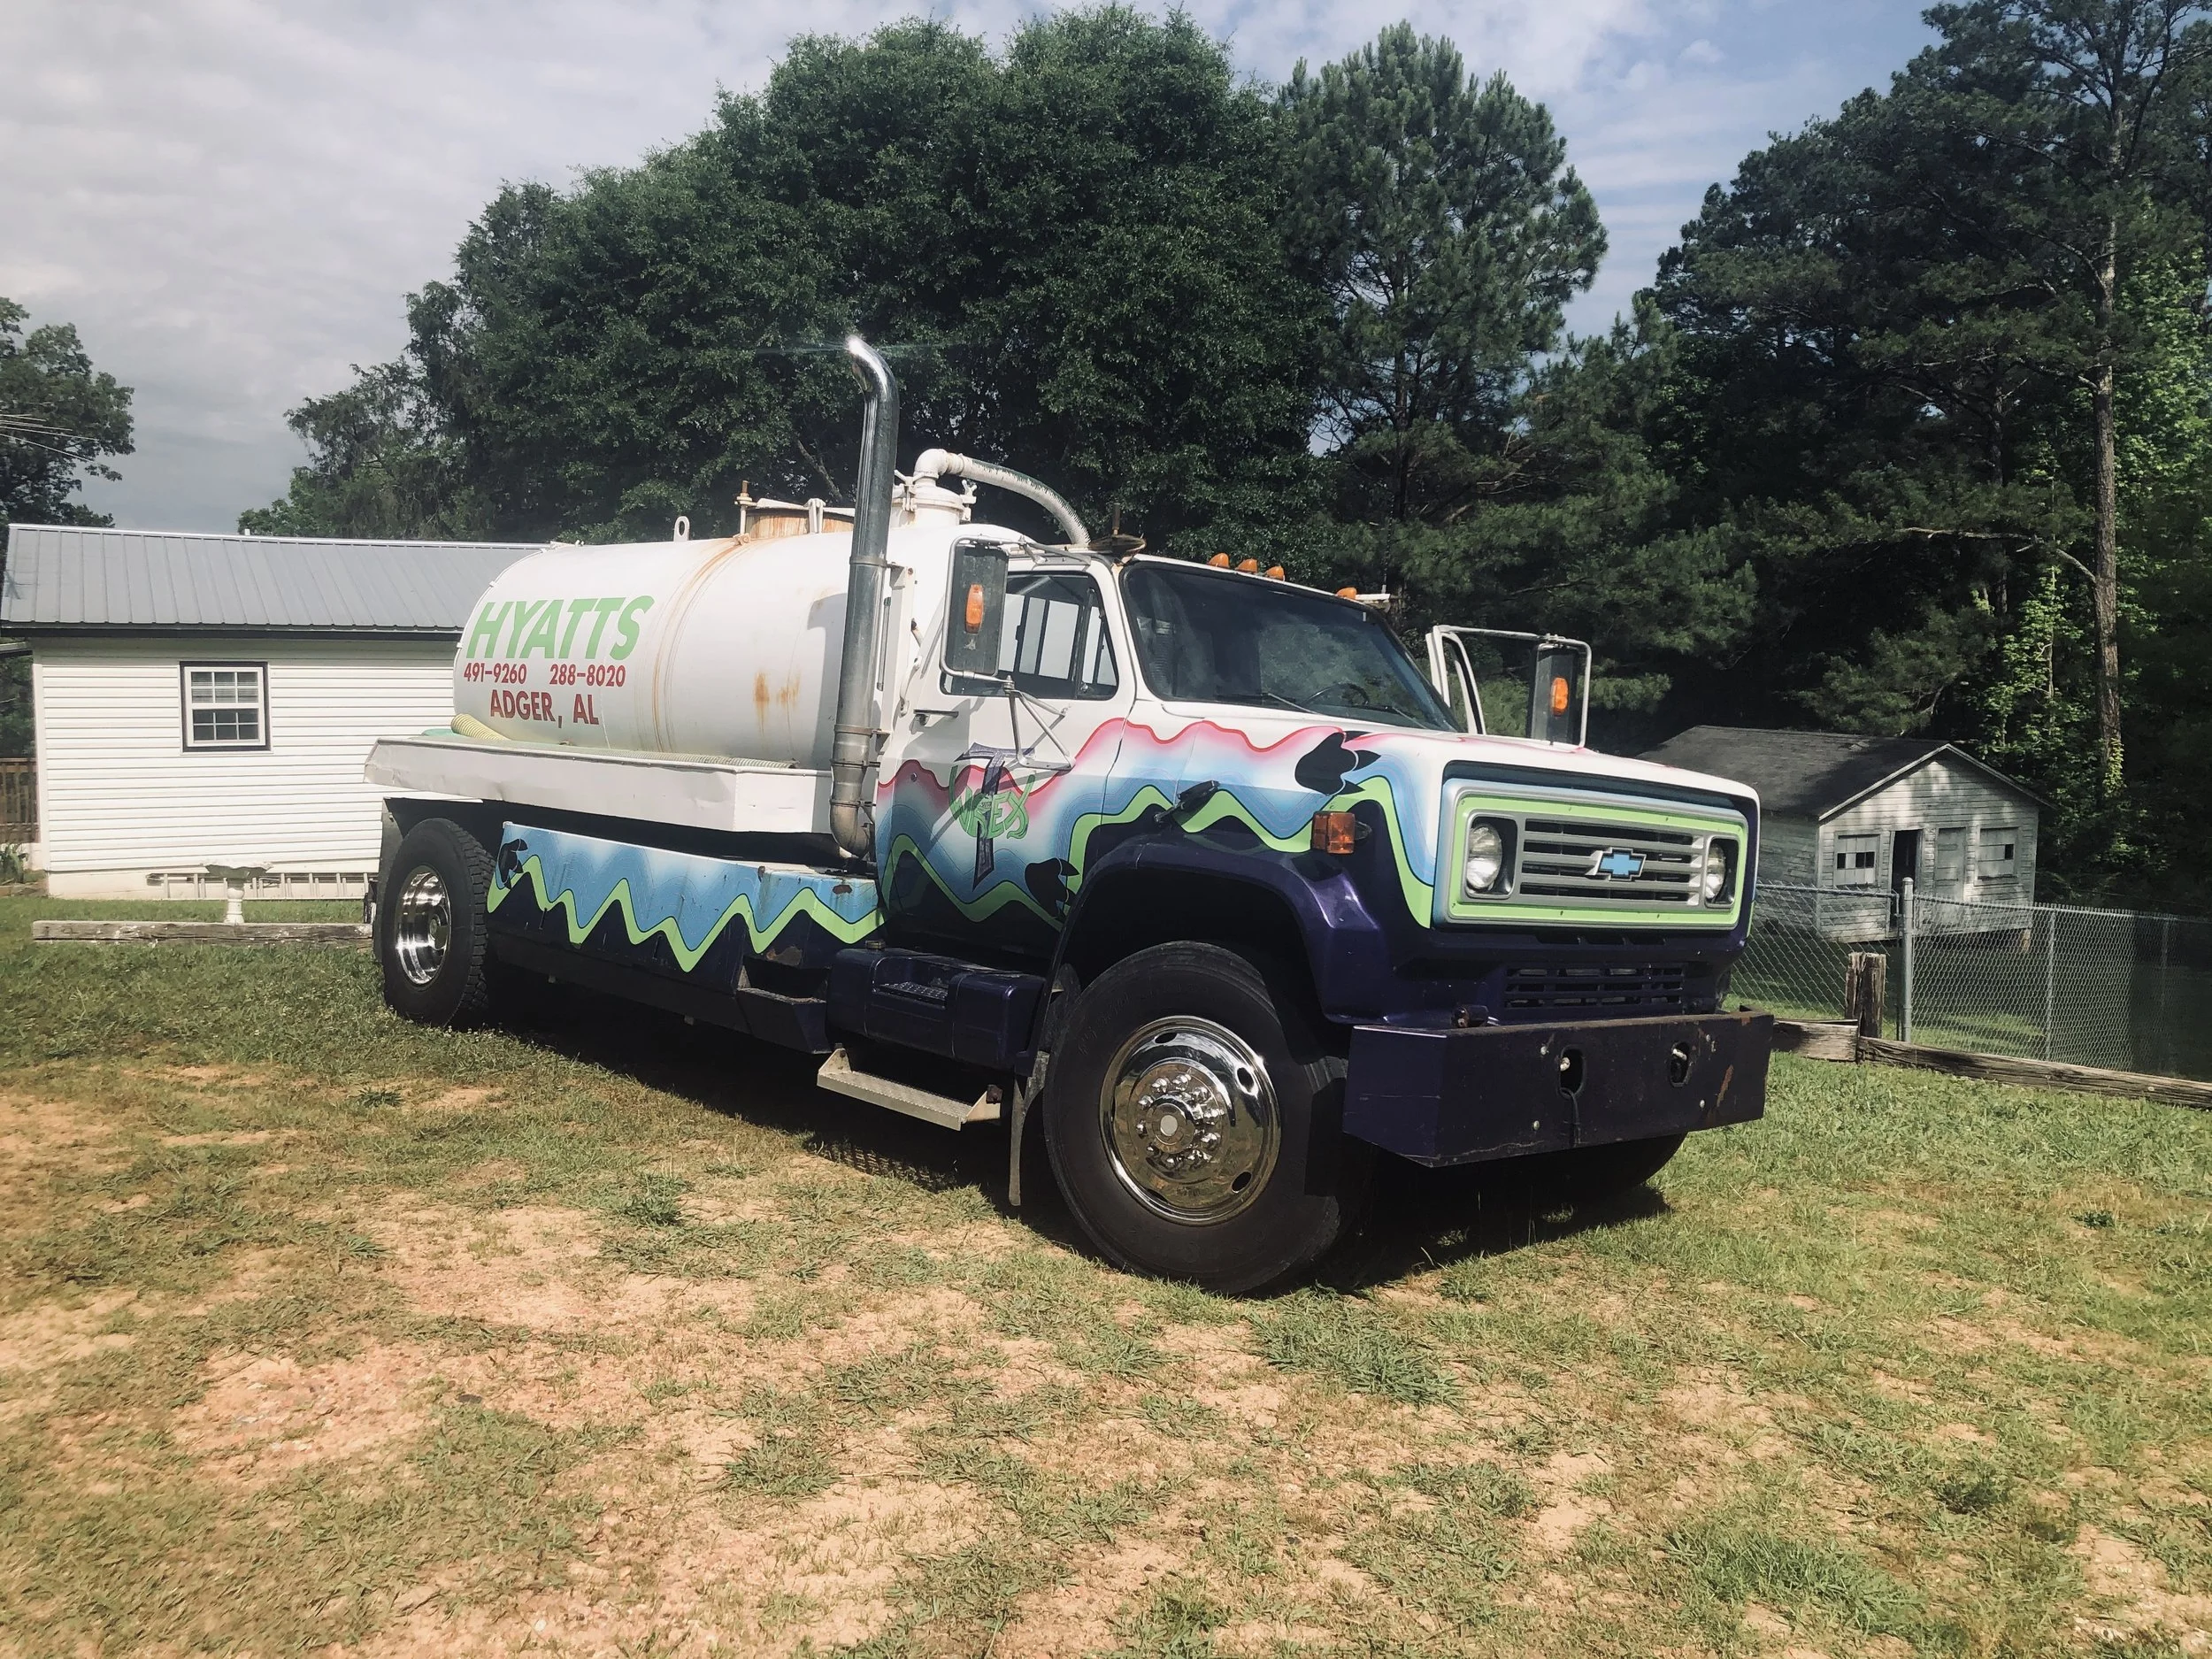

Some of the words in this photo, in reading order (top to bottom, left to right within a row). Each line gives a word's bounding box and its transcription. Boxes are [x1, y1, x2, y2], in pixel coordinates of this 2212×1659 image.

[466, 595, 655, 660] HYATTS
[464, 663, 527, 684] 491-9260
[549, 664, 626, 687] 288-8020
[490, 689, 563, 728] ADGER,
[573, 694, 599, 725] AL
